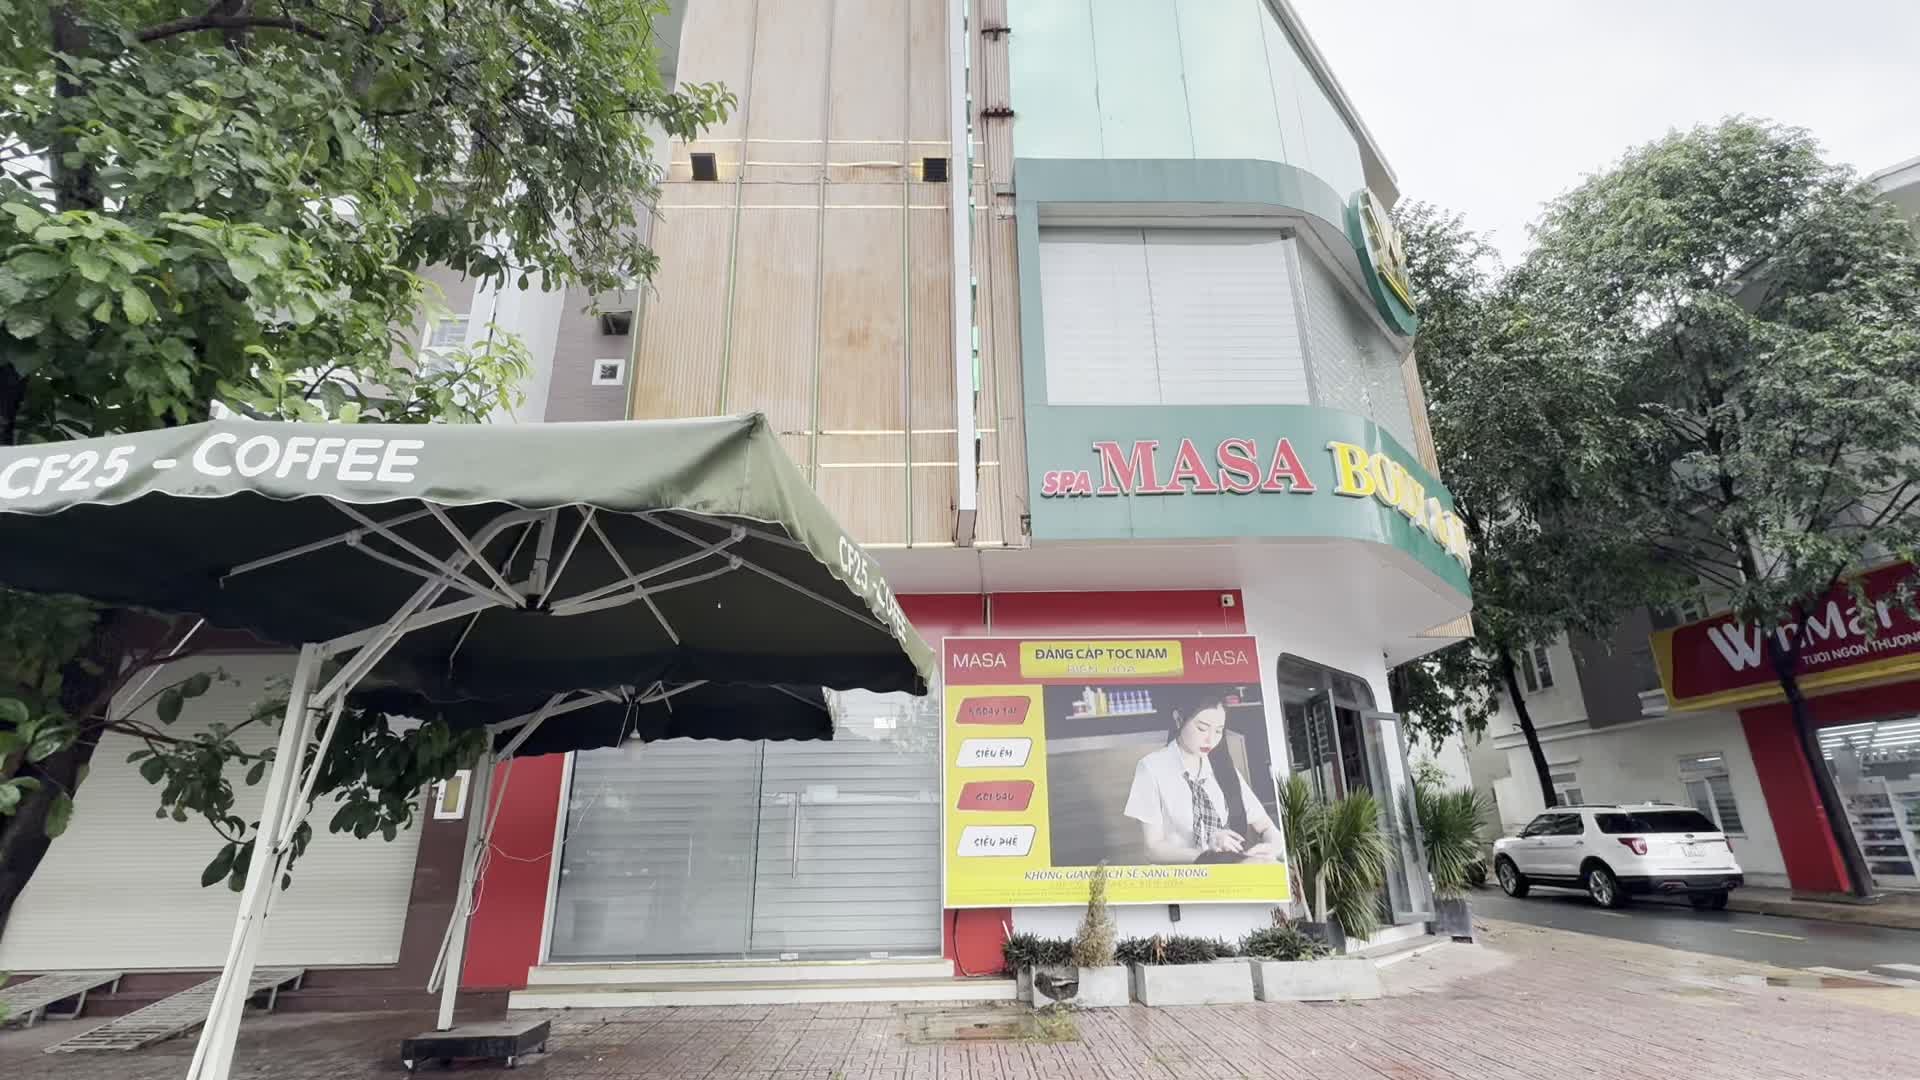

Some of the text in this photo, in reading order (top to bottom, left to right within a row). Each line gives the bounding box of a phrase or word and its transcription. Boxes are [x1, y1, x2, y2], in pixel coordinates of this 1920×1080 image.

[0, 446, 136, 499] CF25
[193, 432, 425, 483] COFFEE
[1041, 470, 1093, 497] SPA
[1093, 437, 1317, 496] MASA
[839, 536, 868, 590] CF25
[952, 652, 1007, 668] MASA
[1135, 648, 1167, 659] NAM
[1195, 649, 1249, 665] MASA
[1832, 640, 1869, 660] NGON
